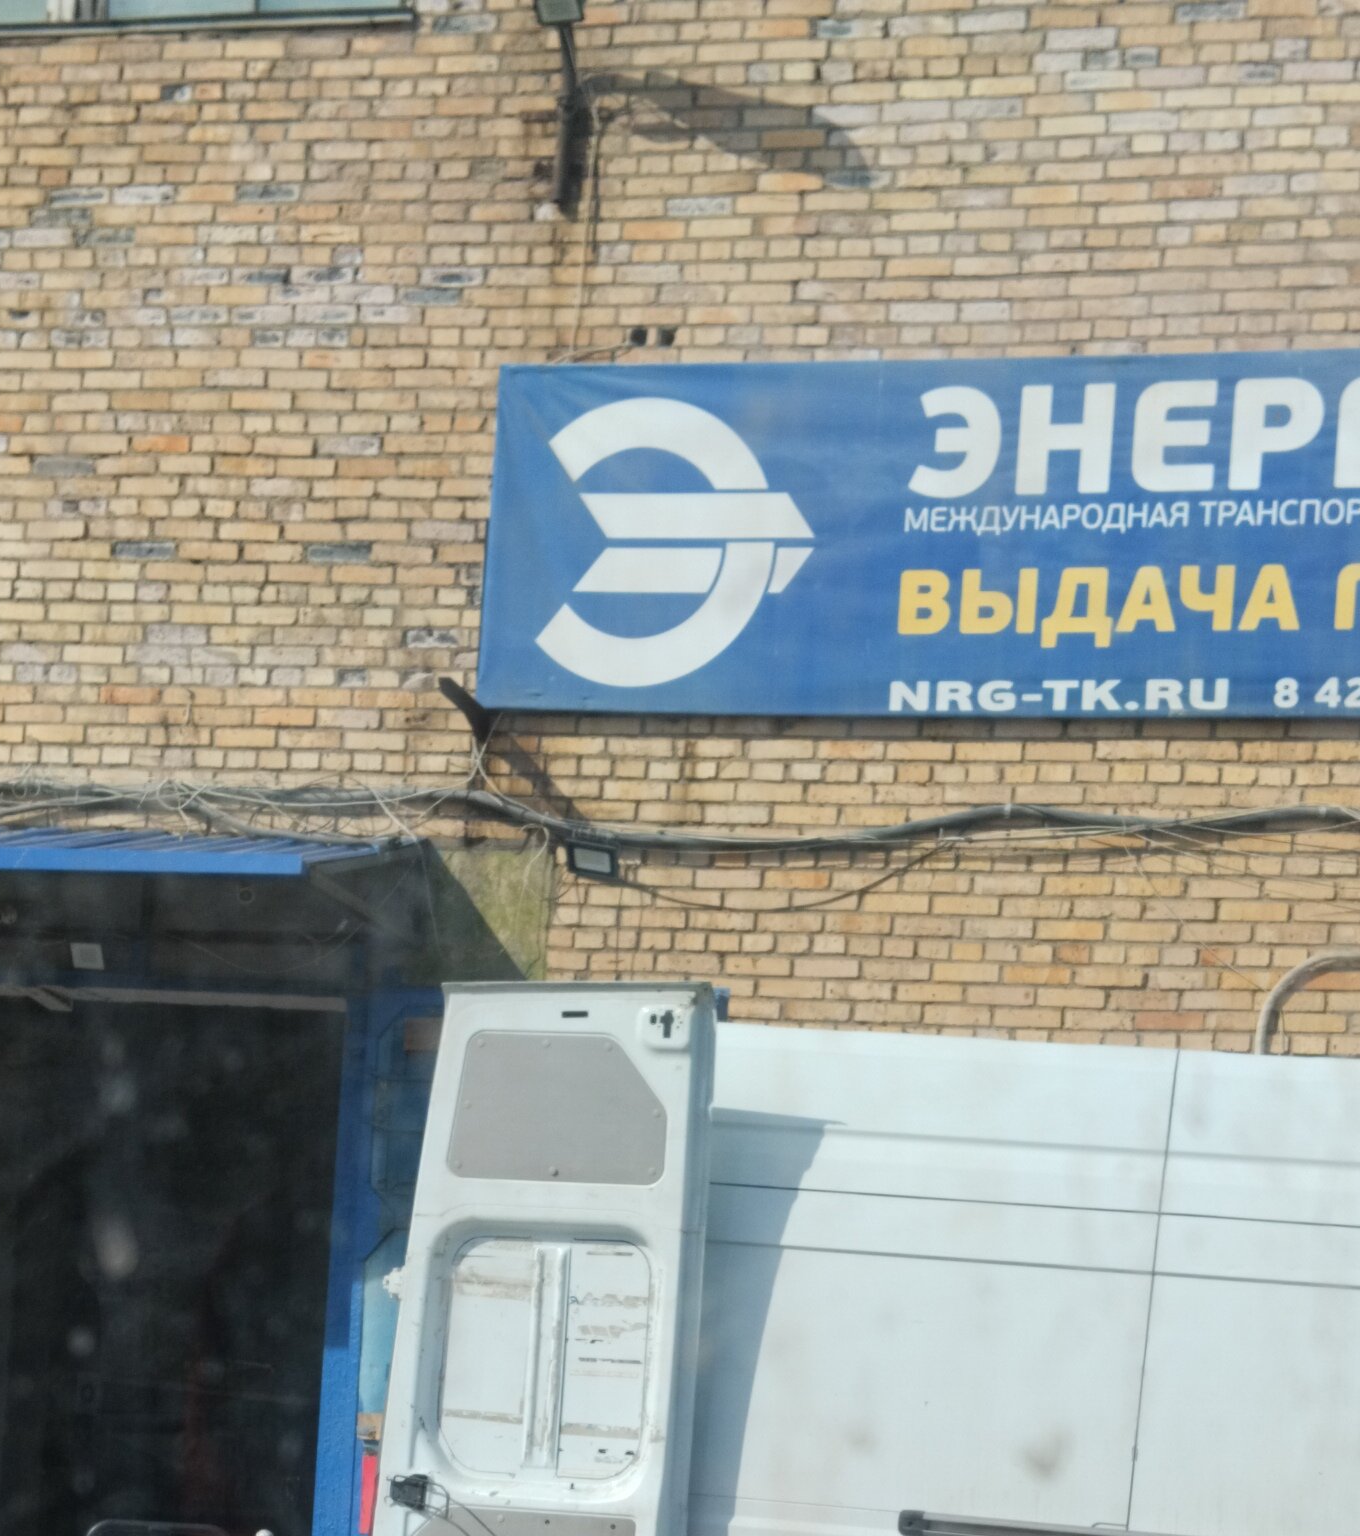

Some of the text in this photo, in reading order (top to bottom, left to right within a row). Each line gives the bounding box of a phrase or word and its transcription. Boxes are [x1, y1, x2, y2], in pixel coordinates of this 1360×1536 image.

[903, 501, 1190, 536] МЕЖДУНАРОДНАЯ
[897, 563, 1301, 649] ВЫДАЧА
[888, 678, 1230, 712] NRG-TK.RU
[1273, 677, 1299, 709] 8
